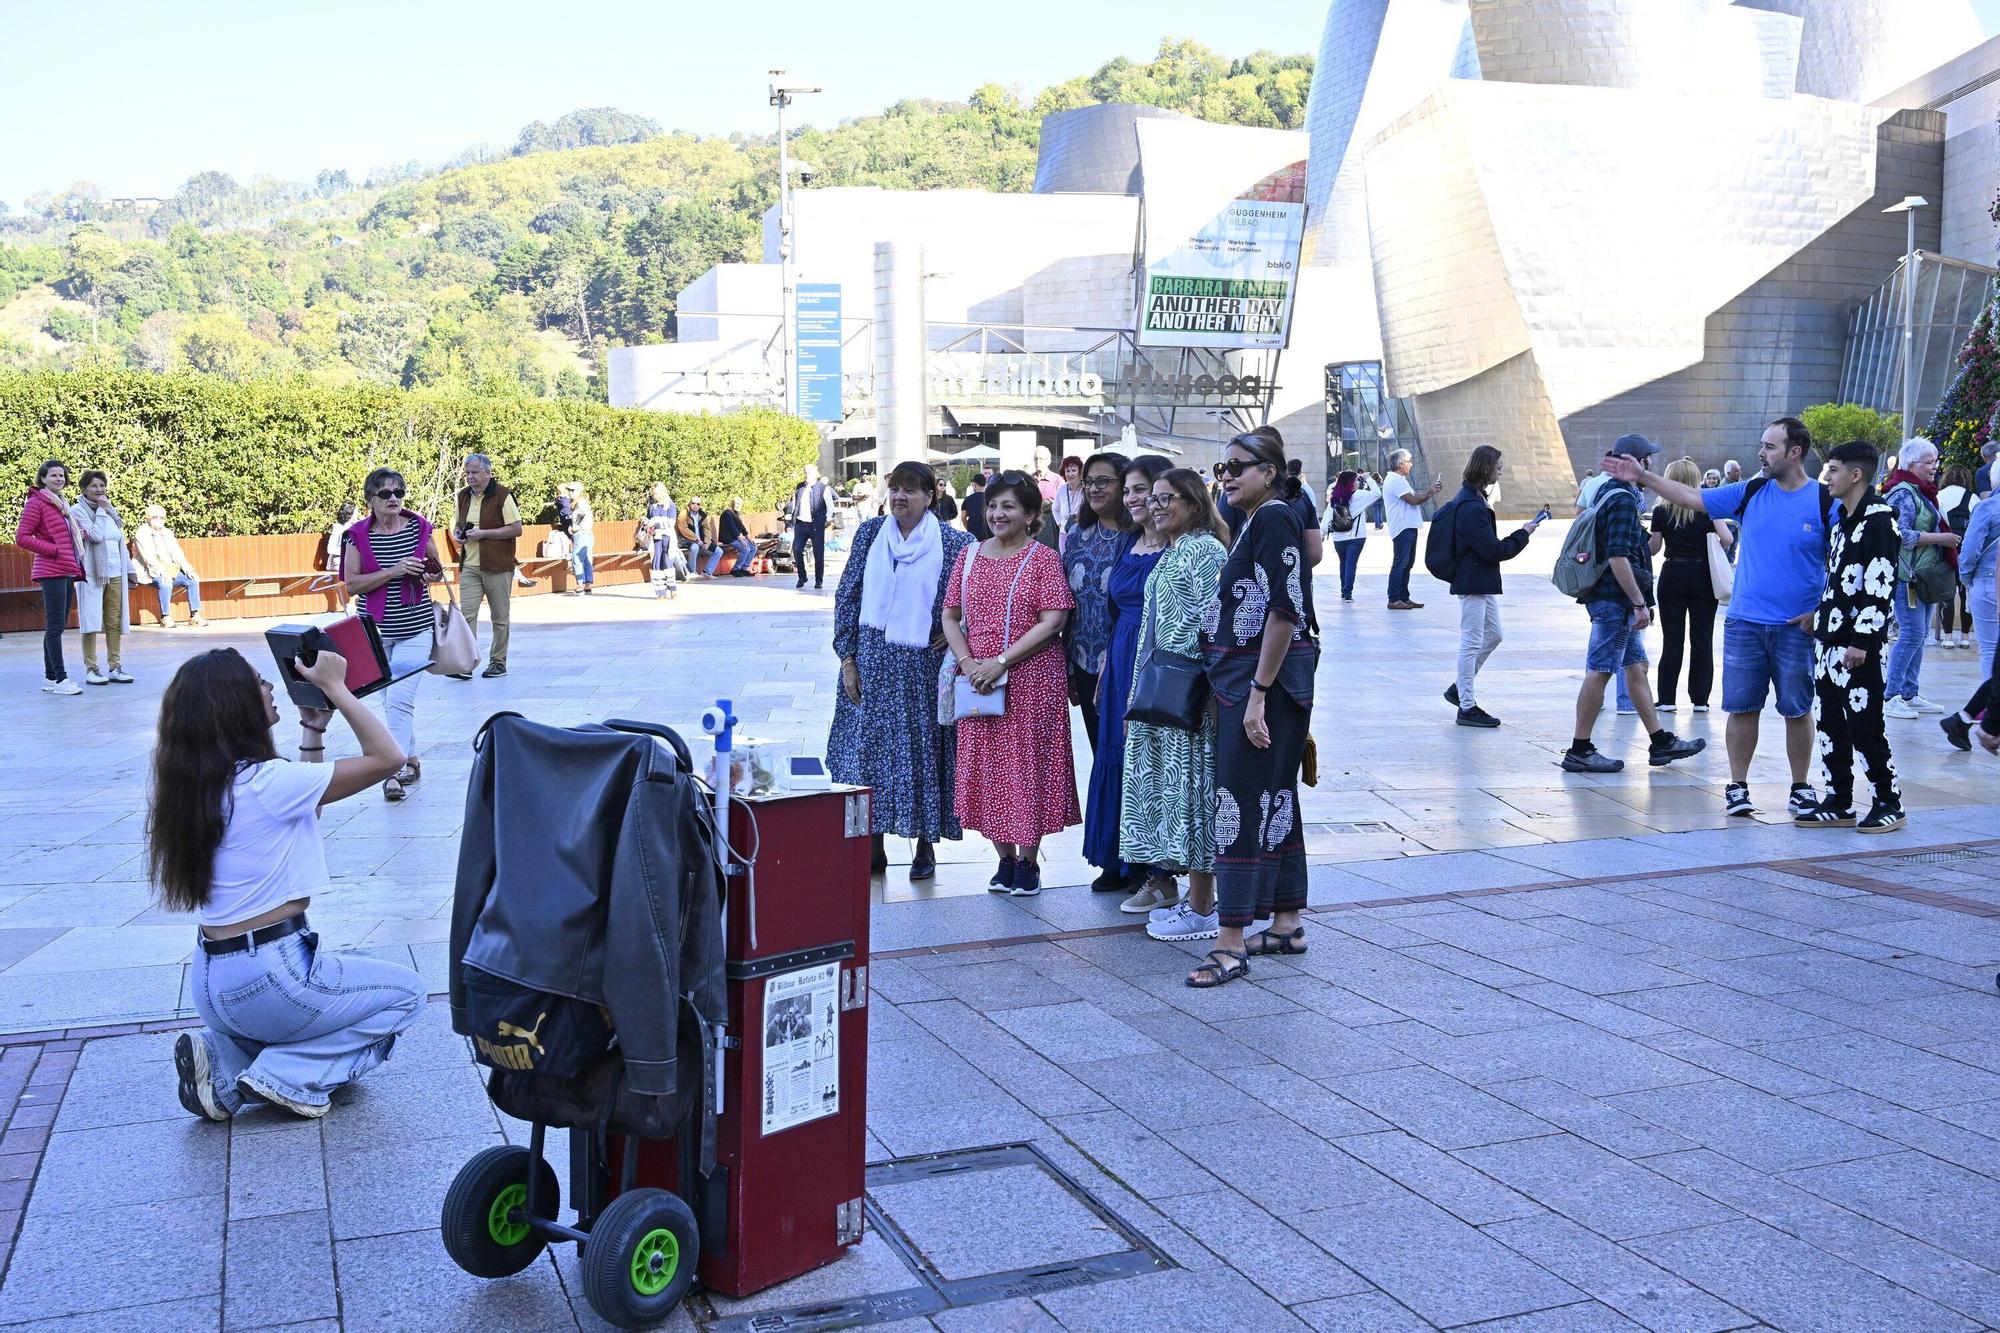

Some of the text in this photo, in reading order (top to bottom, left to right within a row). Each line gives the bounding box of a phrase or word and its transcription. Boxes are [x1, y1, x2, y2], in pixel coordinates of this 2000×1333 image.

[1229, 208, 1287, 219] GUGGENHEIM
[1229, 218, 1259, 227] BILBAO
[1153, 278, 1223, 296] BARBARA
[1152, 296, 1283, 315] ANOTHER DAY
[1149, 312, 1281, 333] ANOTHER NIGHT
[1119, 364, 1262, 396] Museoa
[476, 1034, 534, 1070] PUMA
